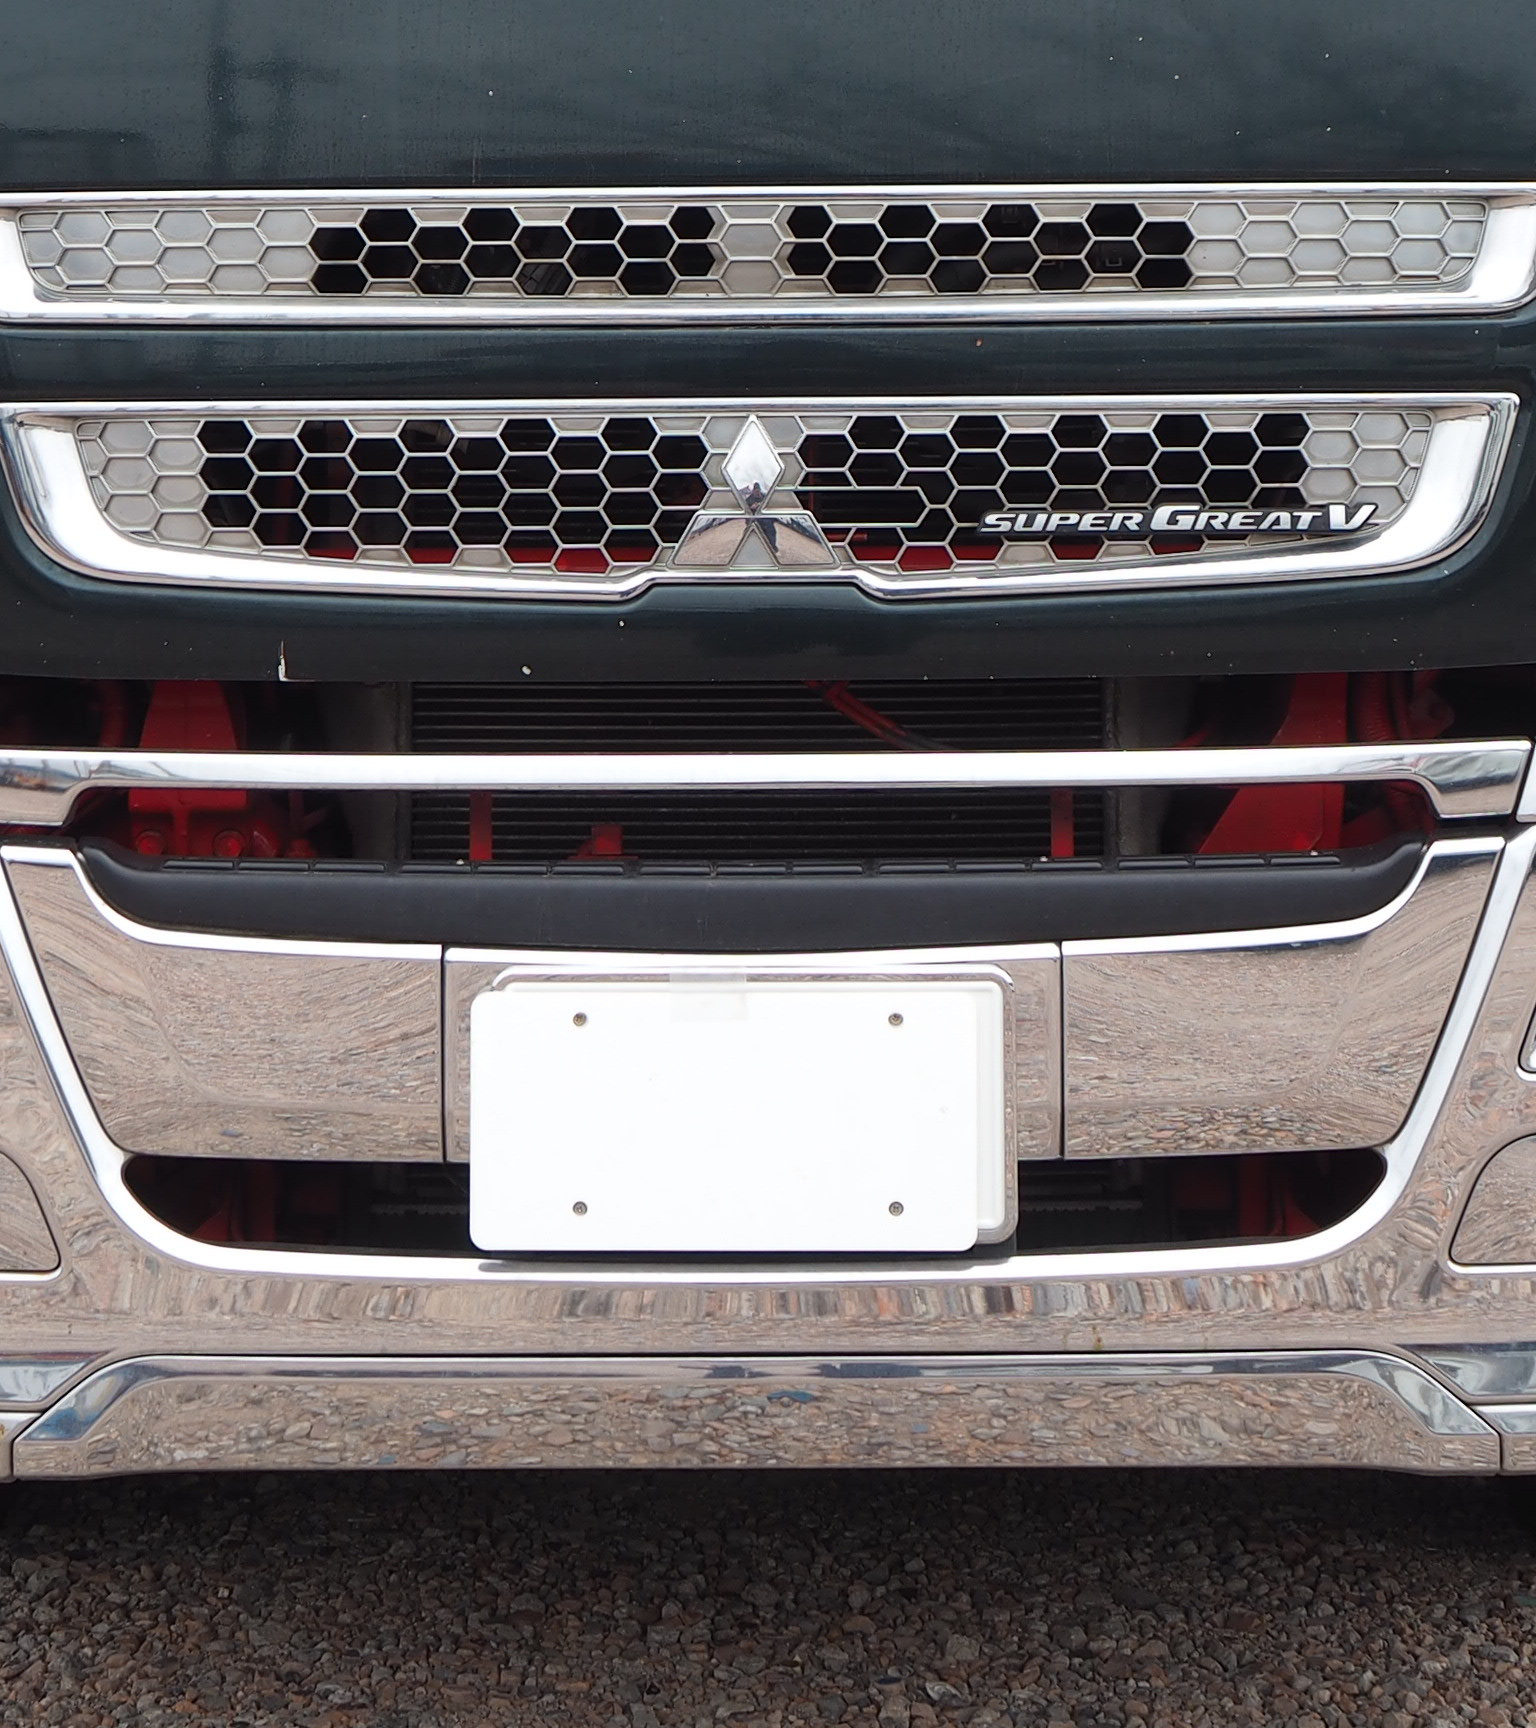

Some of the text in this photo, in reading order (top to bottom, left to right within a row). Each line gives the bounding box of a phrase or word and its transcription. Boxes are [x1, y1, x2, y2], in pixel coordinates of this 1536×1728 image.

[980, 504, 1378, 533] SUPER GREAT V
